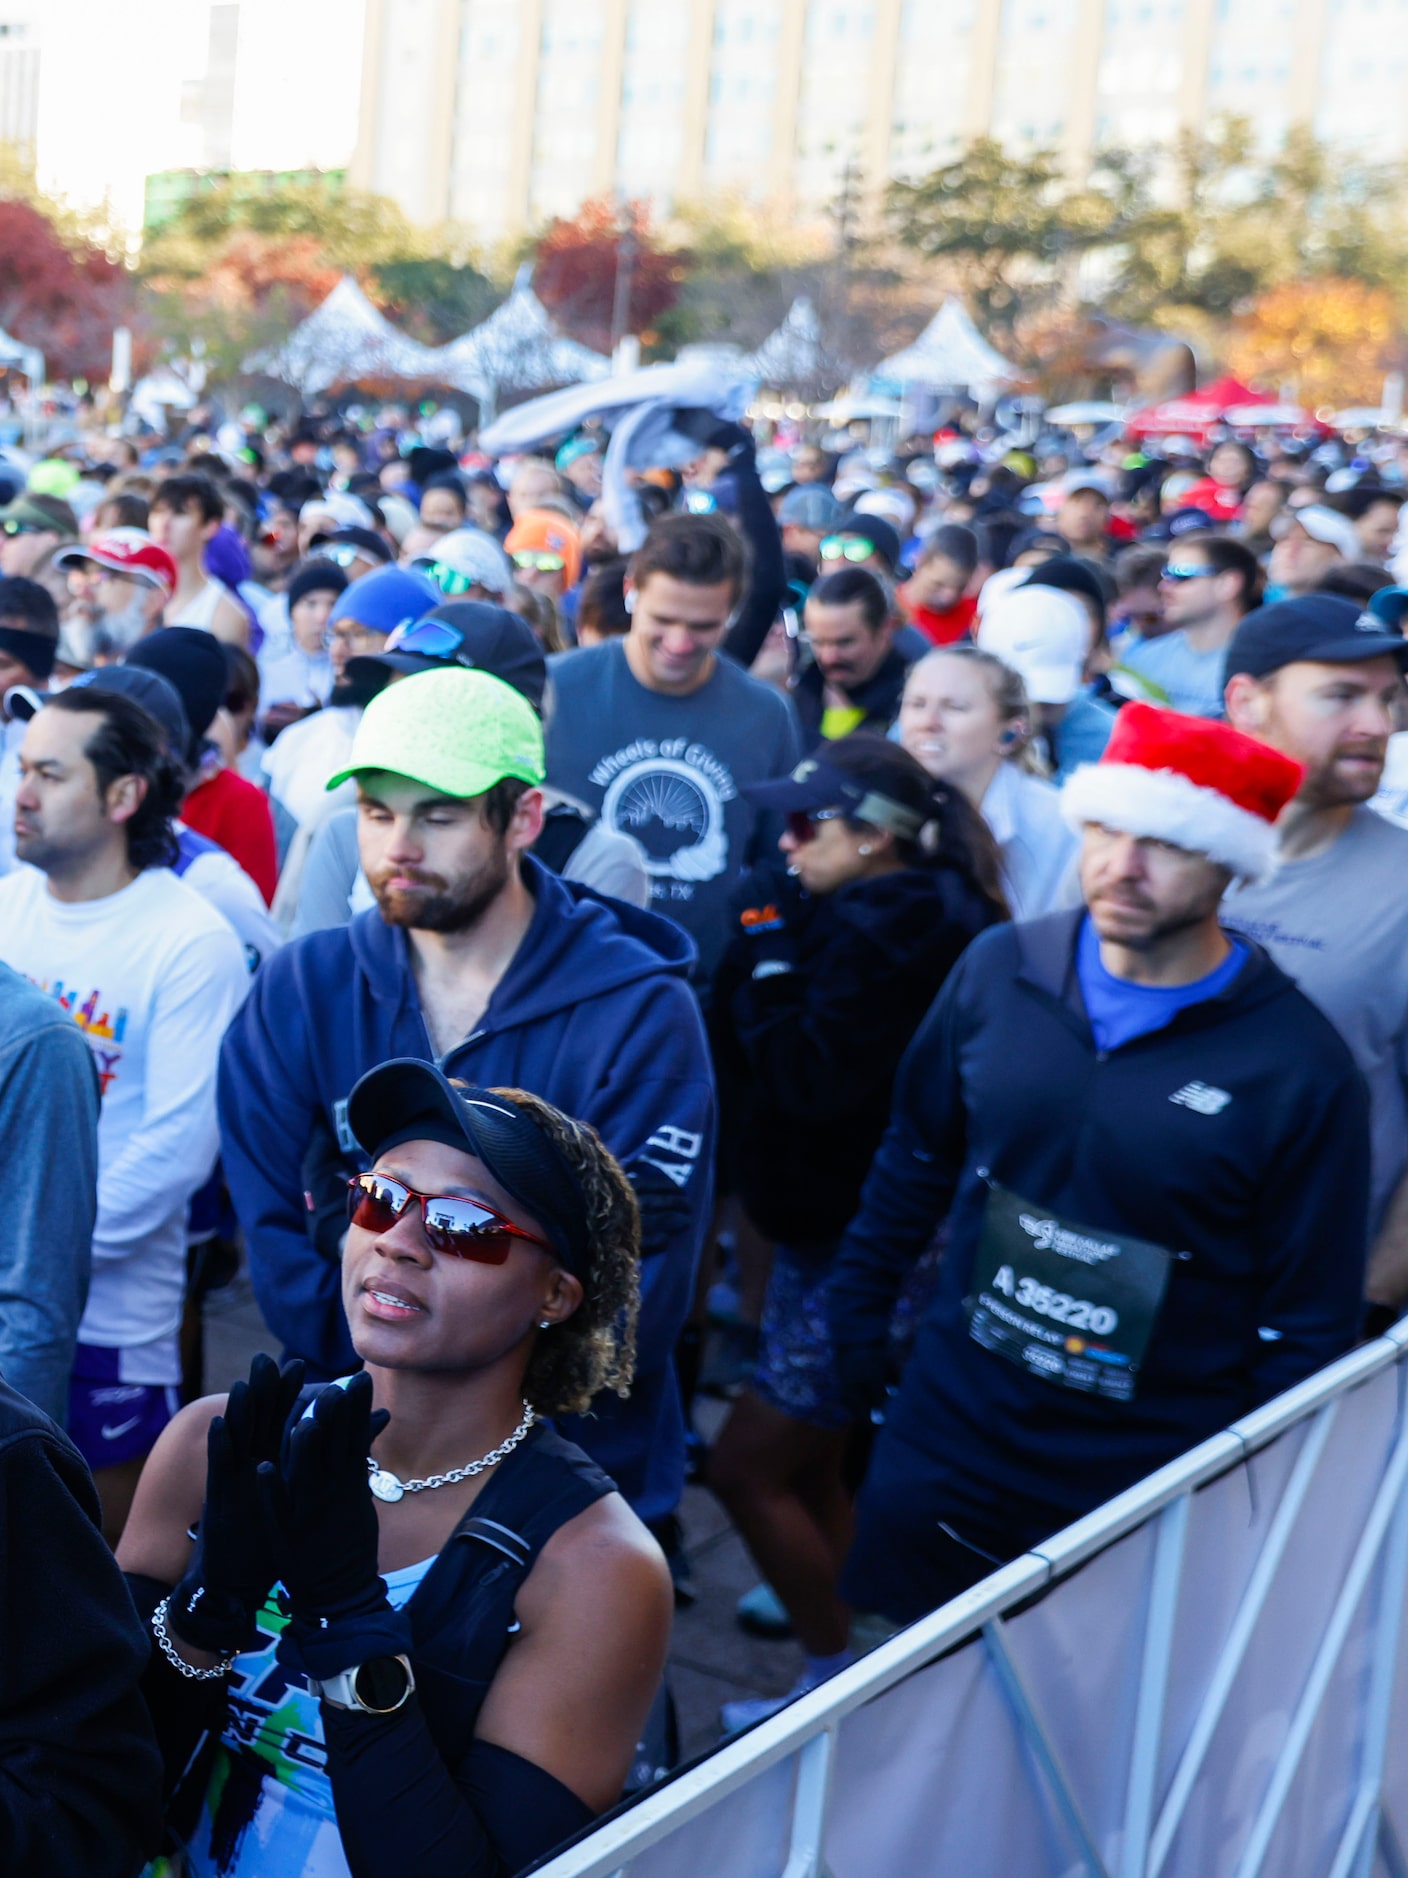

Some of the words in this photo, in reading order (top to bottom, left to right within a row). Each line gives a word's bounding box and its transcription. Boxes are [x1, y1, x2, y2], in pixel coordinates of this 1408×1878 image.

[588, 736, 658, 787] Wheels
[659, 736, 688, 758] of
[685, 743, 738, 801] Giving
